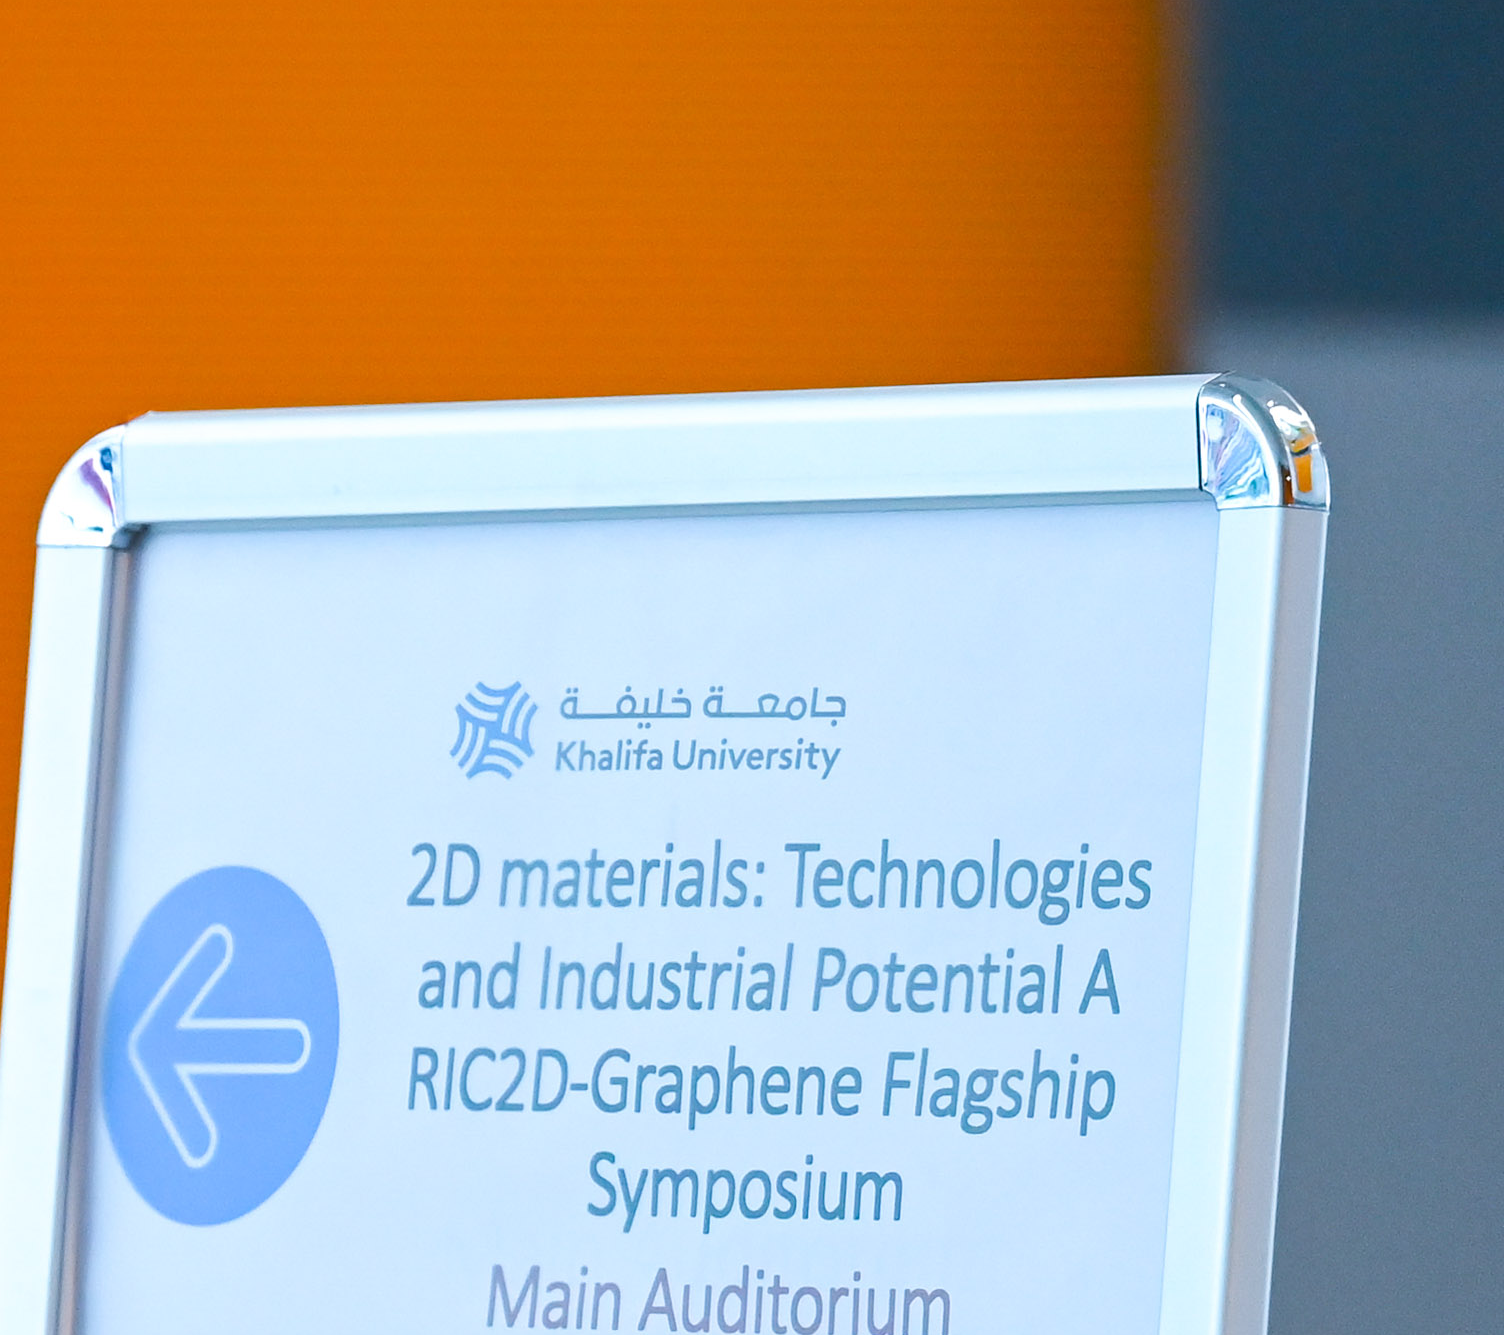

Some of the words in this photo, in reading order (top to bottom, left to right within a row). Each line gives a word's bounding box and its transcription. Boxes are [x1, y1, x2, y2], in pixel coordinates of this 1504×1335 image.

[559, 685, 692, 730] خليفة
[702, 686, 847, 728] جامعة
[555, 739, 664, 772] Khalifa
[672, 737, 842, 781] University
[406, 842, 481, 908] 2D
[498, 838, 765, 909] materials:
[783, 838, 1153, 926] Technologies
[418, 941, 522, 1011] and
[539, 941, 795, 1012] Industrial
[811, 943, 1064, 1015] Potential
[1078, 948, 1121, 1015] A
[407, 1045, 863, 1131] RIC2D-Graphene
[882, 1047, 1116, 1137] Flagship
[586, 1150, 903, 1235] Symposium
[486, 1264, 621, 1331] Main
